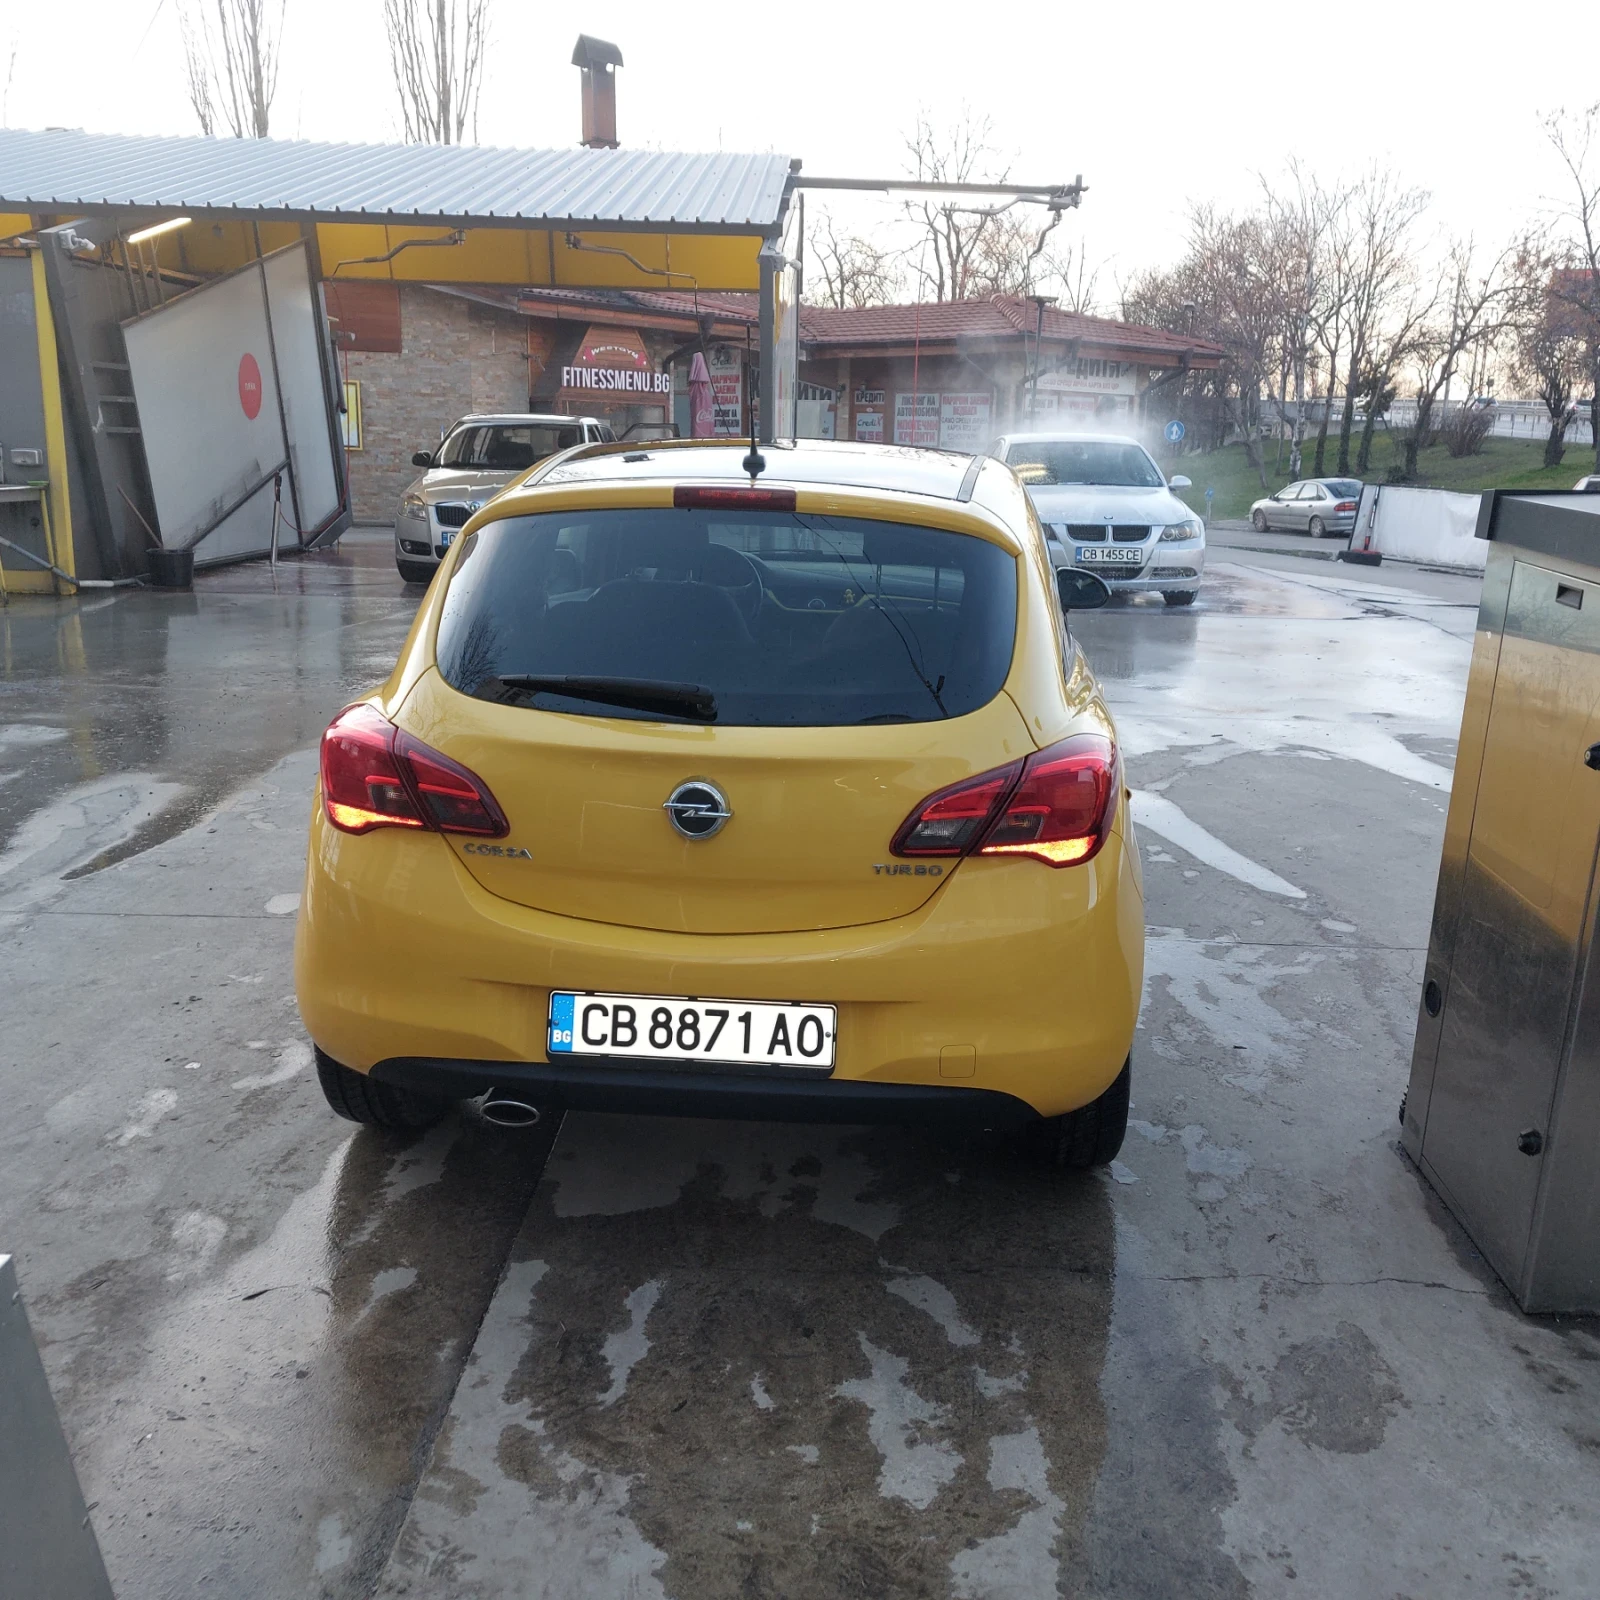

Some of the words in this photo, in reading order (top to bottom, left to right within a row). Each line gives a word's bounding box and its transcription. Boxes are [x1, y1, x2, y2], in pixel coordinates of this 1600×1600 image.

[563, 366, 670, 393] FITNESSMENU.BG
[898, 431, 935, 443] КРДИТИ
[1083, 549, 1097, 560] CB
[1101, 549, 1125, 560] 1455
[1126, 550, 1139, 560] CE
[463, 842, 533, 860] CORSA
[872, 863, 943, 876] TURBO
[552, 1029, 572, 1043] BG
[581, 1003, 638, 1048] CB
[648, 1006, 752, 1054] 8871
[766, 1012, 825, 1058] AO
